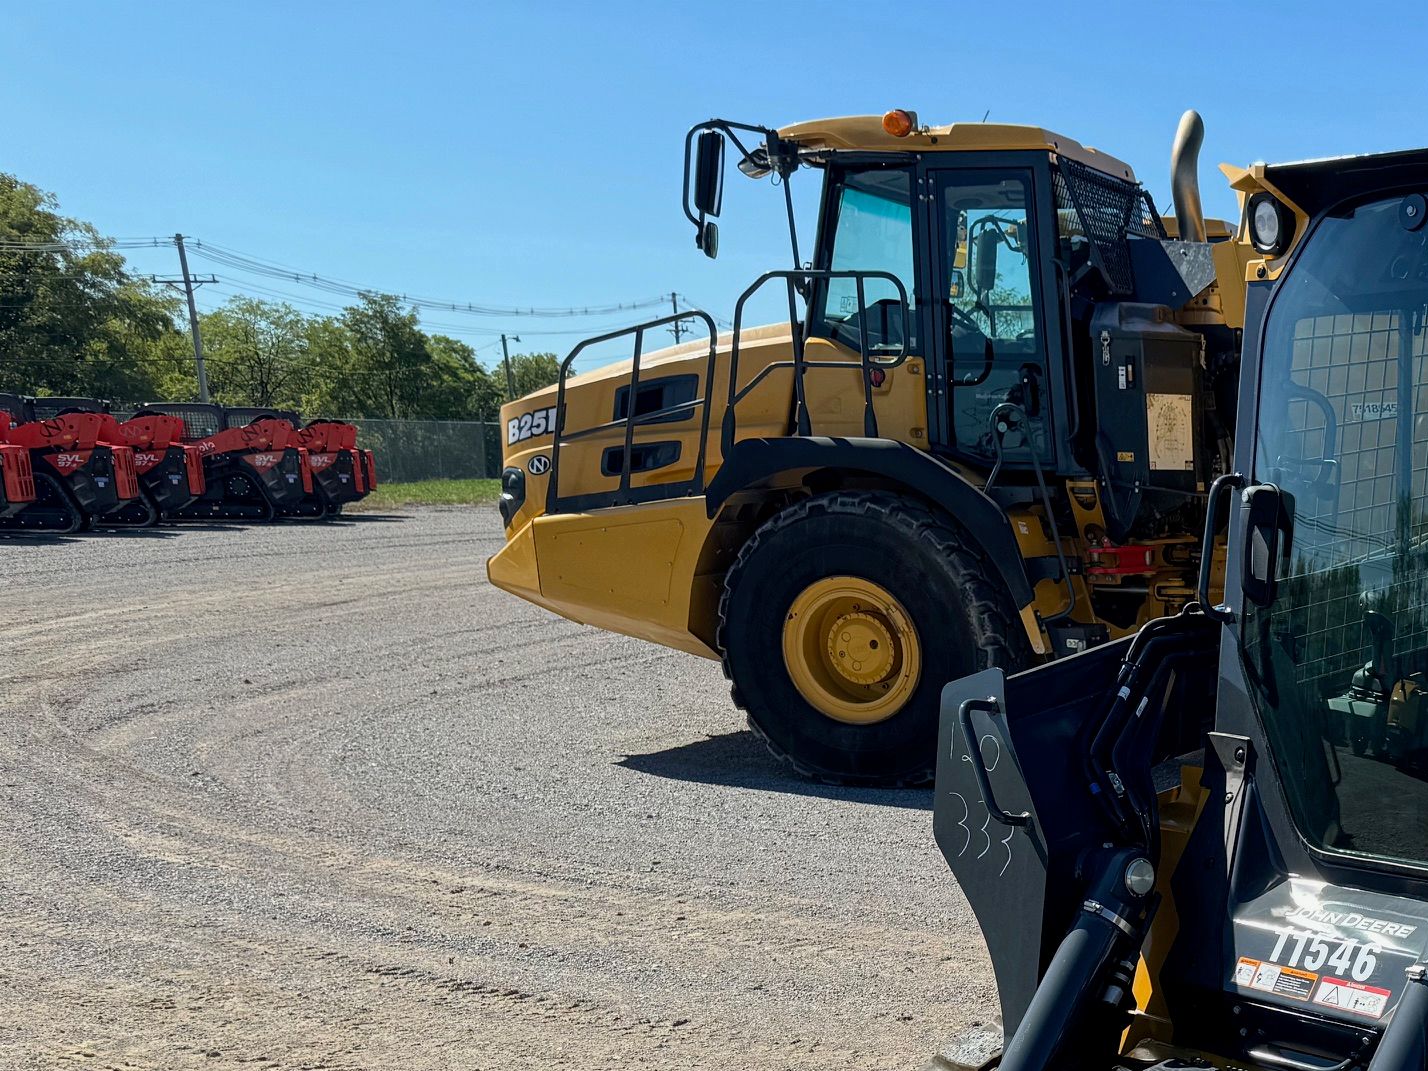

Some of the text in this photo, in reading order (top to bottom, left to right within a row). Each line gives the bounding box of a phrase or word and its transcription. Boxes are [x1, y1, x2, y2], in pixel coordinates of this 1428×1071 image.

[1285, 907, 1418, 939] JOHN DEERE
[1268, 926, 1382, 982] 11546
